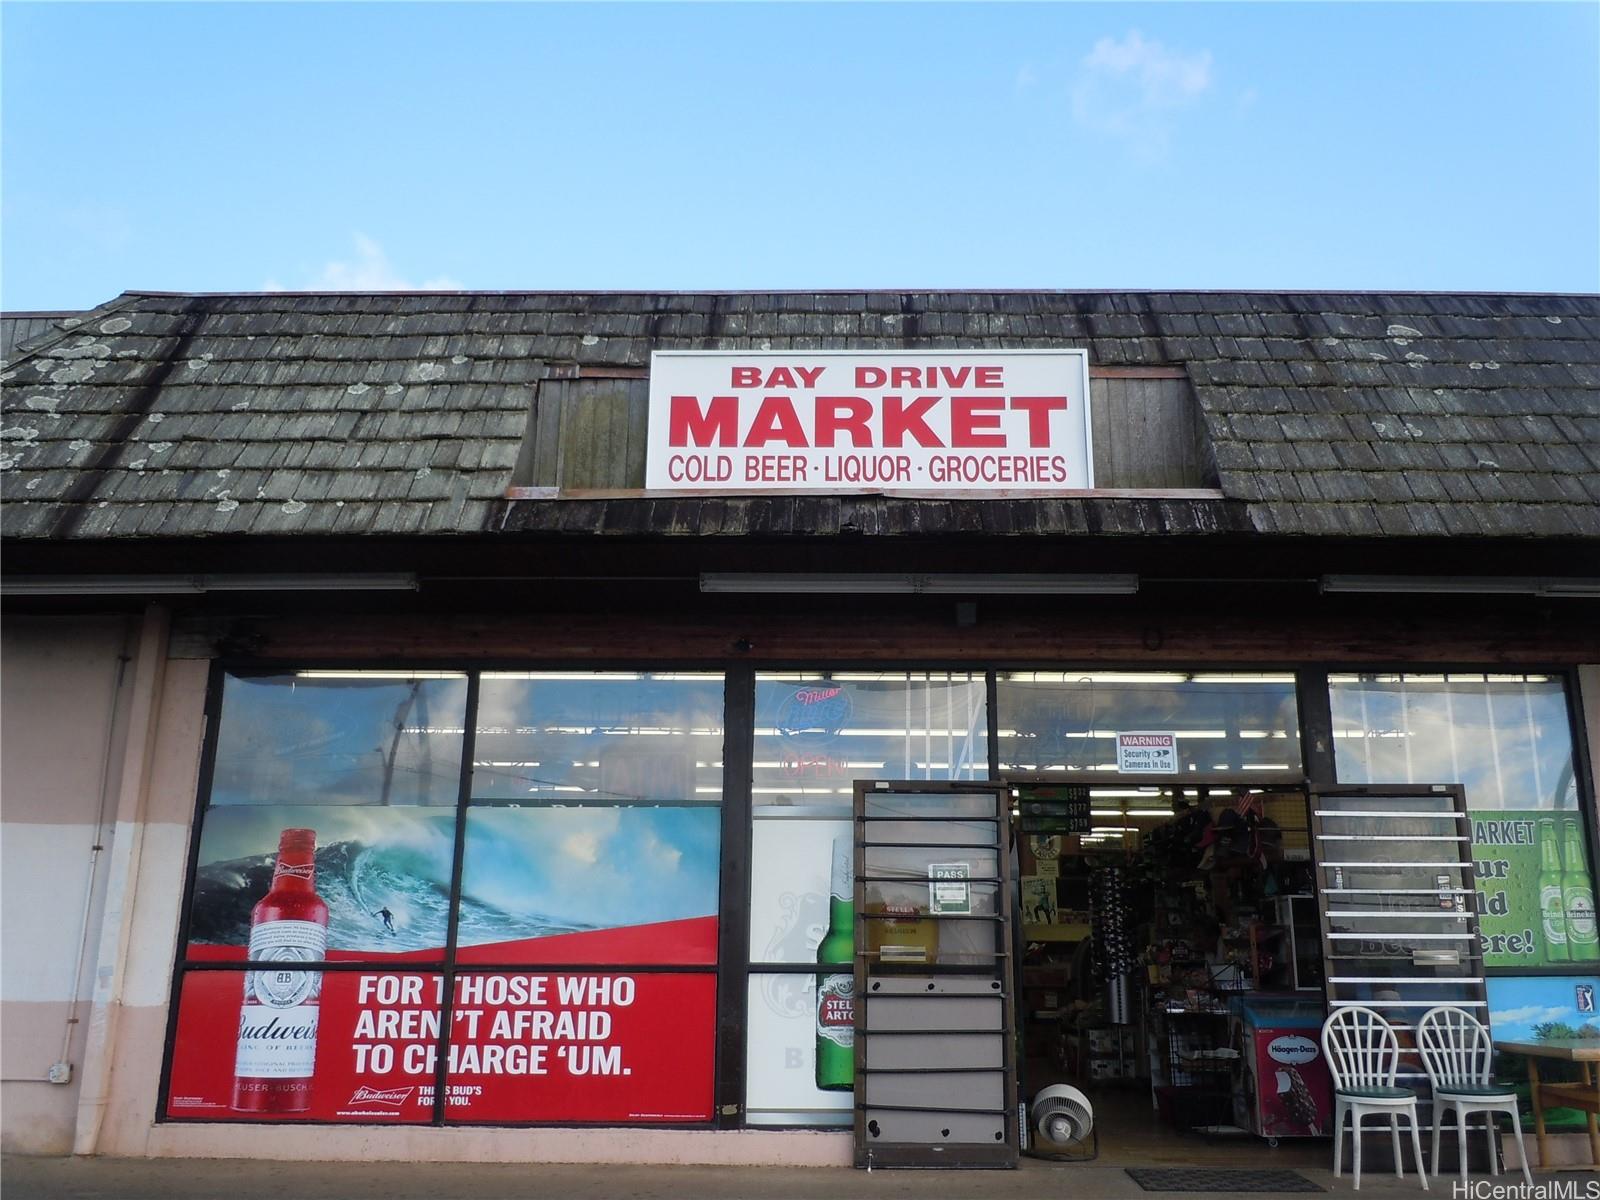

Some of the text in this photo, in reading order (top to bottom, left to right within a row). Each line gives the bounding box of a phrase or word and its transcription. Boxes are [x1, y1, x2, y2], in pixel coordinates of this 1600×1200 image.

[731, 366, 1004, 389] BAY DRIVE
[668, 396, 1067, 448] MARKET
[668, 455, 1066, 483] COLD BEER LIQUOR GROCERIES
[795, 686, 844, 706] Miller
[1122, 736, 1171, 746] WARNING
[783, 752, 846, 777] OPEN
[1123, 749, 1151, 760] Security
[1124, 760, 1151, 769] Cameras
[1160, 760, 1171, 769] Use
[1471, 820, 1535, 845] ARKET
[937, 871, 964, 879] PASS
[1474, 860, 1509, 878] ur
[1477, 891, 1508, 916] ld
[1480, 929, 1534, 954] ere!
[358, 975, 636, 1006] FOR THOSE WHO
[826, 1000, 854, 1010] STEL
[240, 1012, 317, 1040] udweis
[490, 1010, 612, 1040] AFRAID
[352, 1043, 394, 1074] TO
[403, 1044, 548, 1075] CHARGE
[354, 1088, 408, 1101] Budweiser
[453, 1086, 482, 1096] BUD'S
[450, 1097, 471, 1106] YOU.
